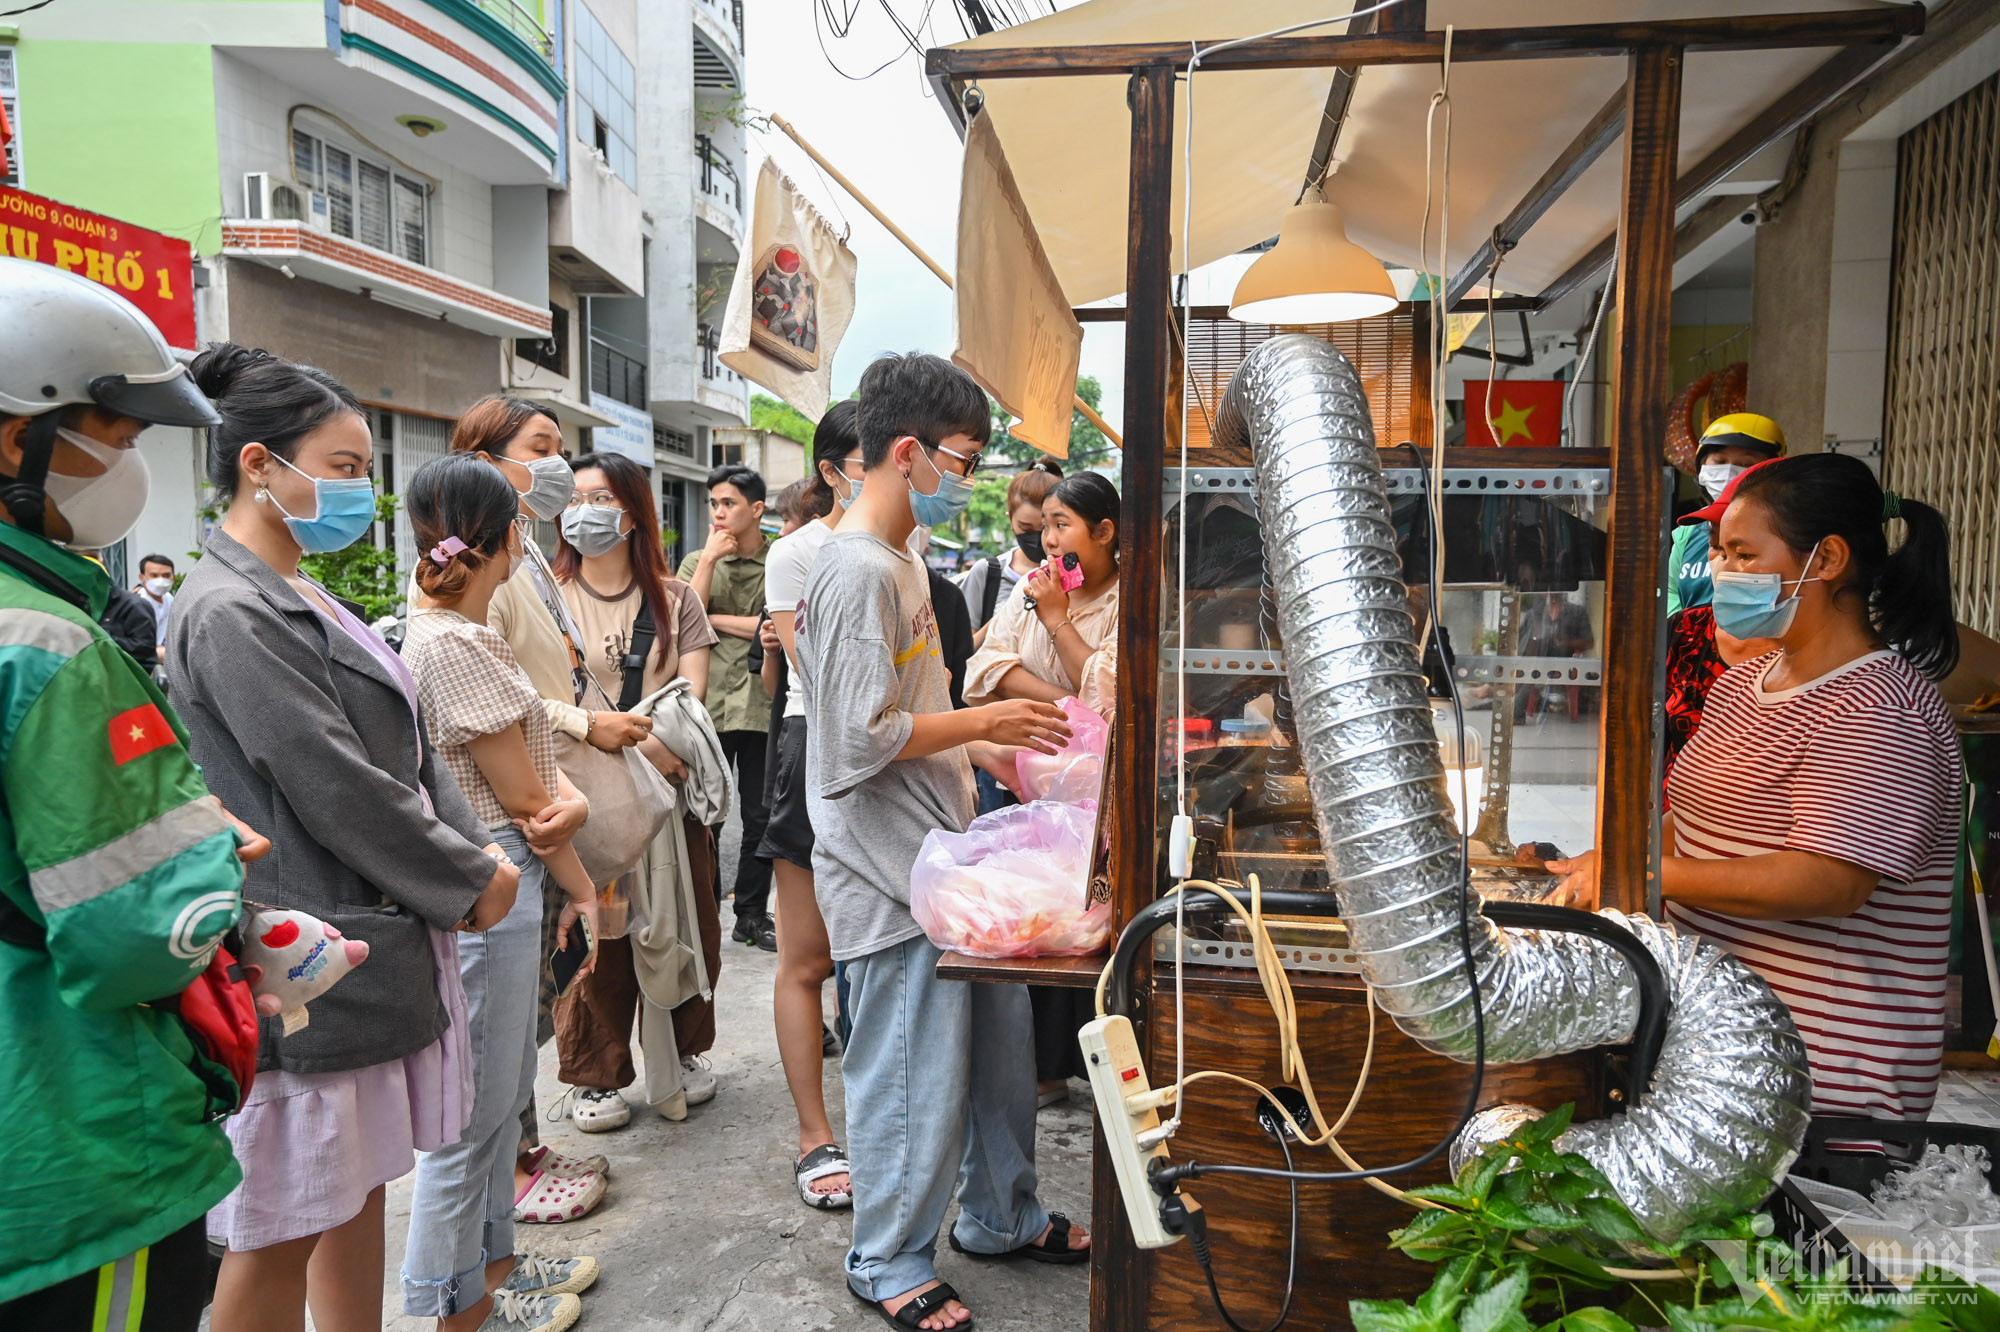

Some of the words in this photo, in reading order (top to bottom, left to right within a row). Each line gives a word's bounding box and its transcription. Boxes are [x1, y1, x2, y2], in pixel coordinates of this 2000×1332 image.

[110, 228, 118, 242] 3
[53, 238, 145, 292] PHỐ
[156, 267, 174, 300] 1
